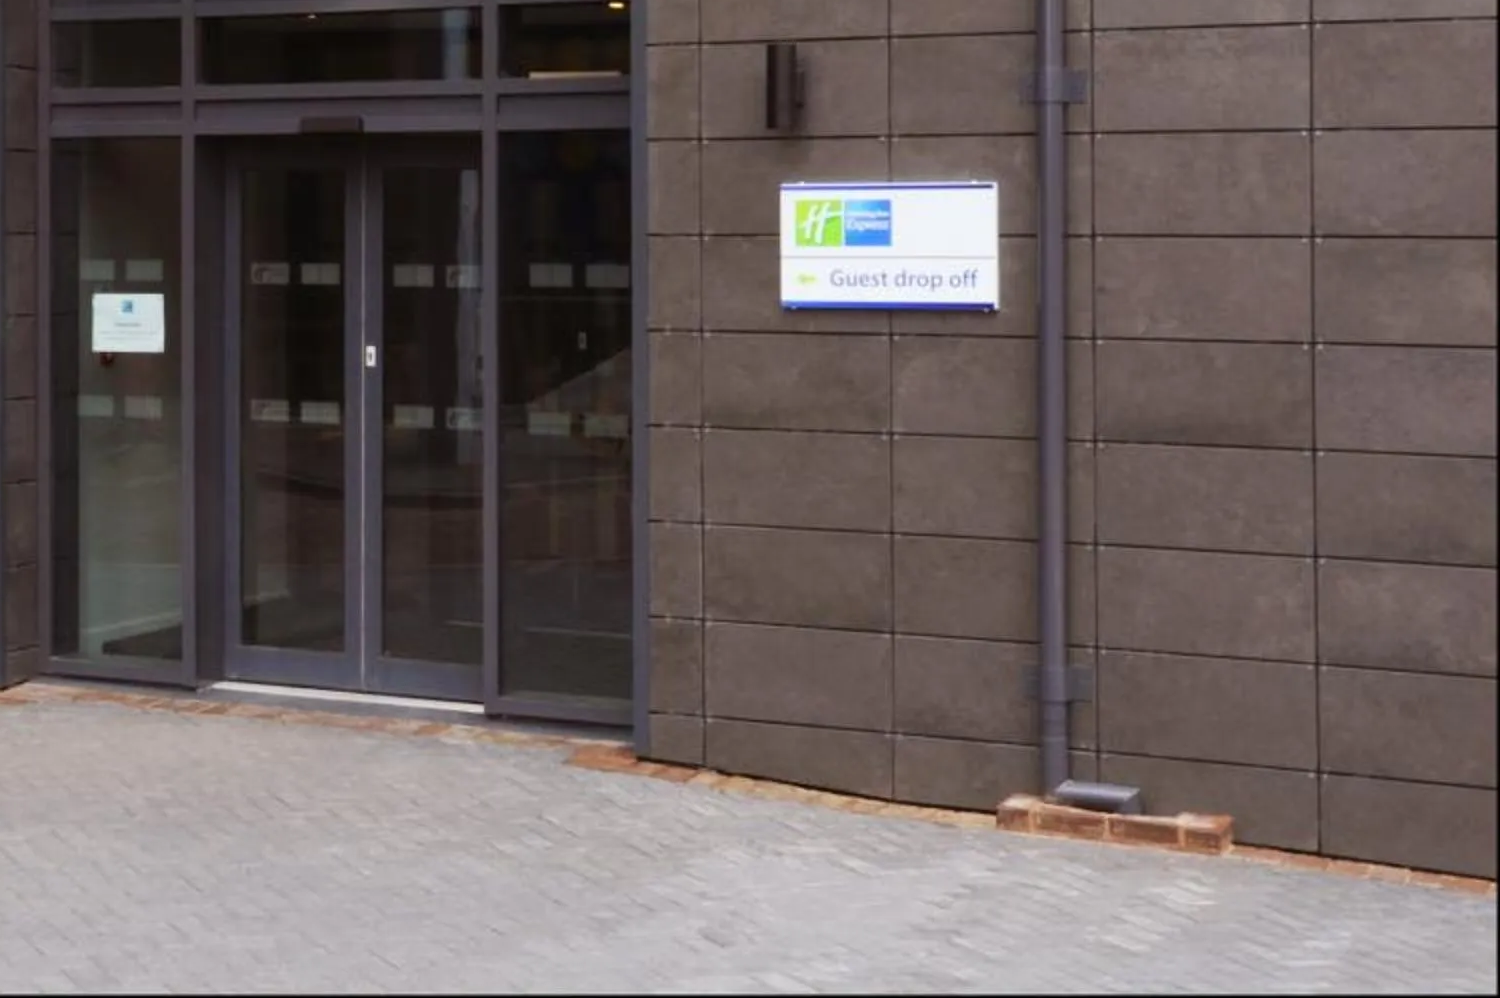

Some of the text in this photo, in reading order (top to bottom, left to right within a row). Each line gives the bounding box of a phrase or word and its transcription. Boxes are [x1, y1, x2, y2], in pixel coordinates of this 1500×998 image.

[829, 269, 978, 291] Guest drop off
